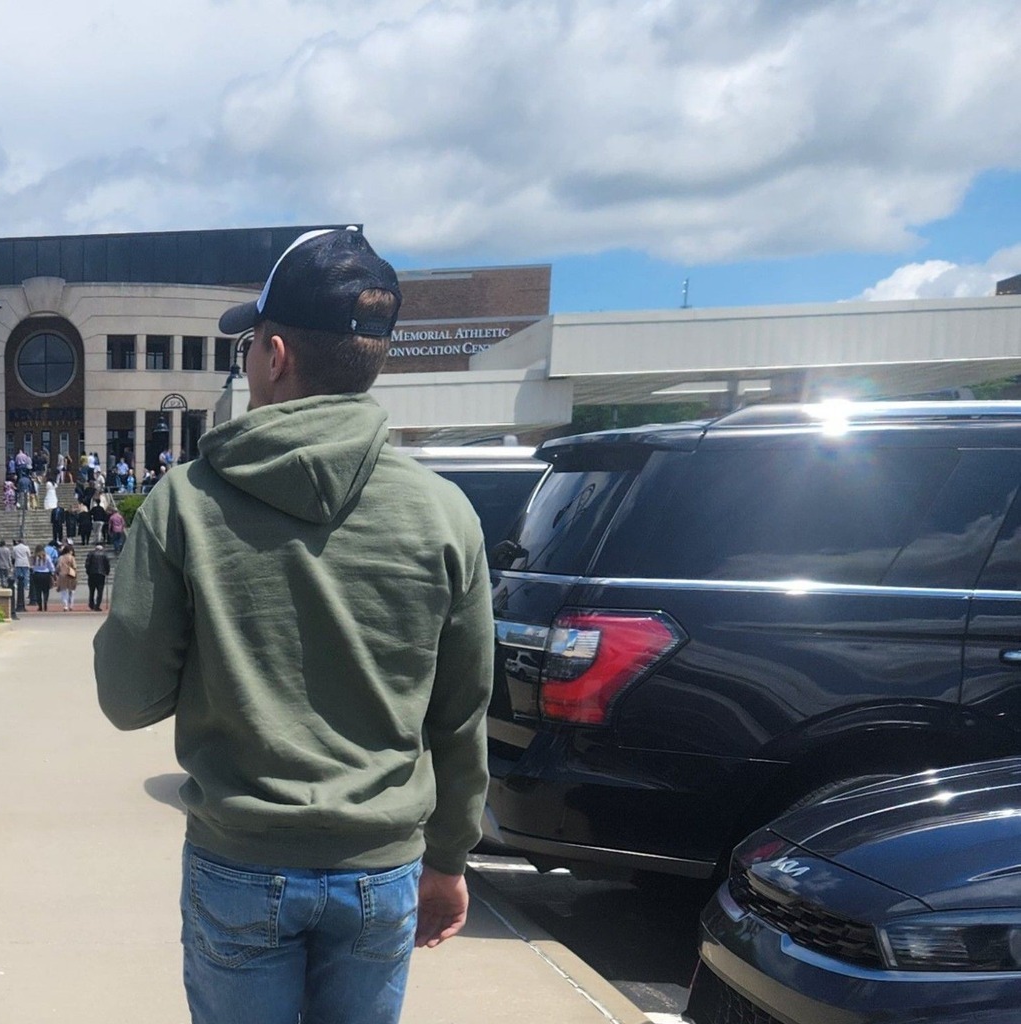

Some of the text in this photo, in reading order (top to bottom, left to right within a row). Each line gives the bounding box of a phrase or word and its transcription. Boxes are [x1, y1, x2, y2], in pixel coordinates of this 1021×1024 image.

[390, 327, 511, 341] MEMORIAL ATHLETIC
[387, 345, 462, 357] ONVOCATION
[770, 856, 811, 877] KIA
